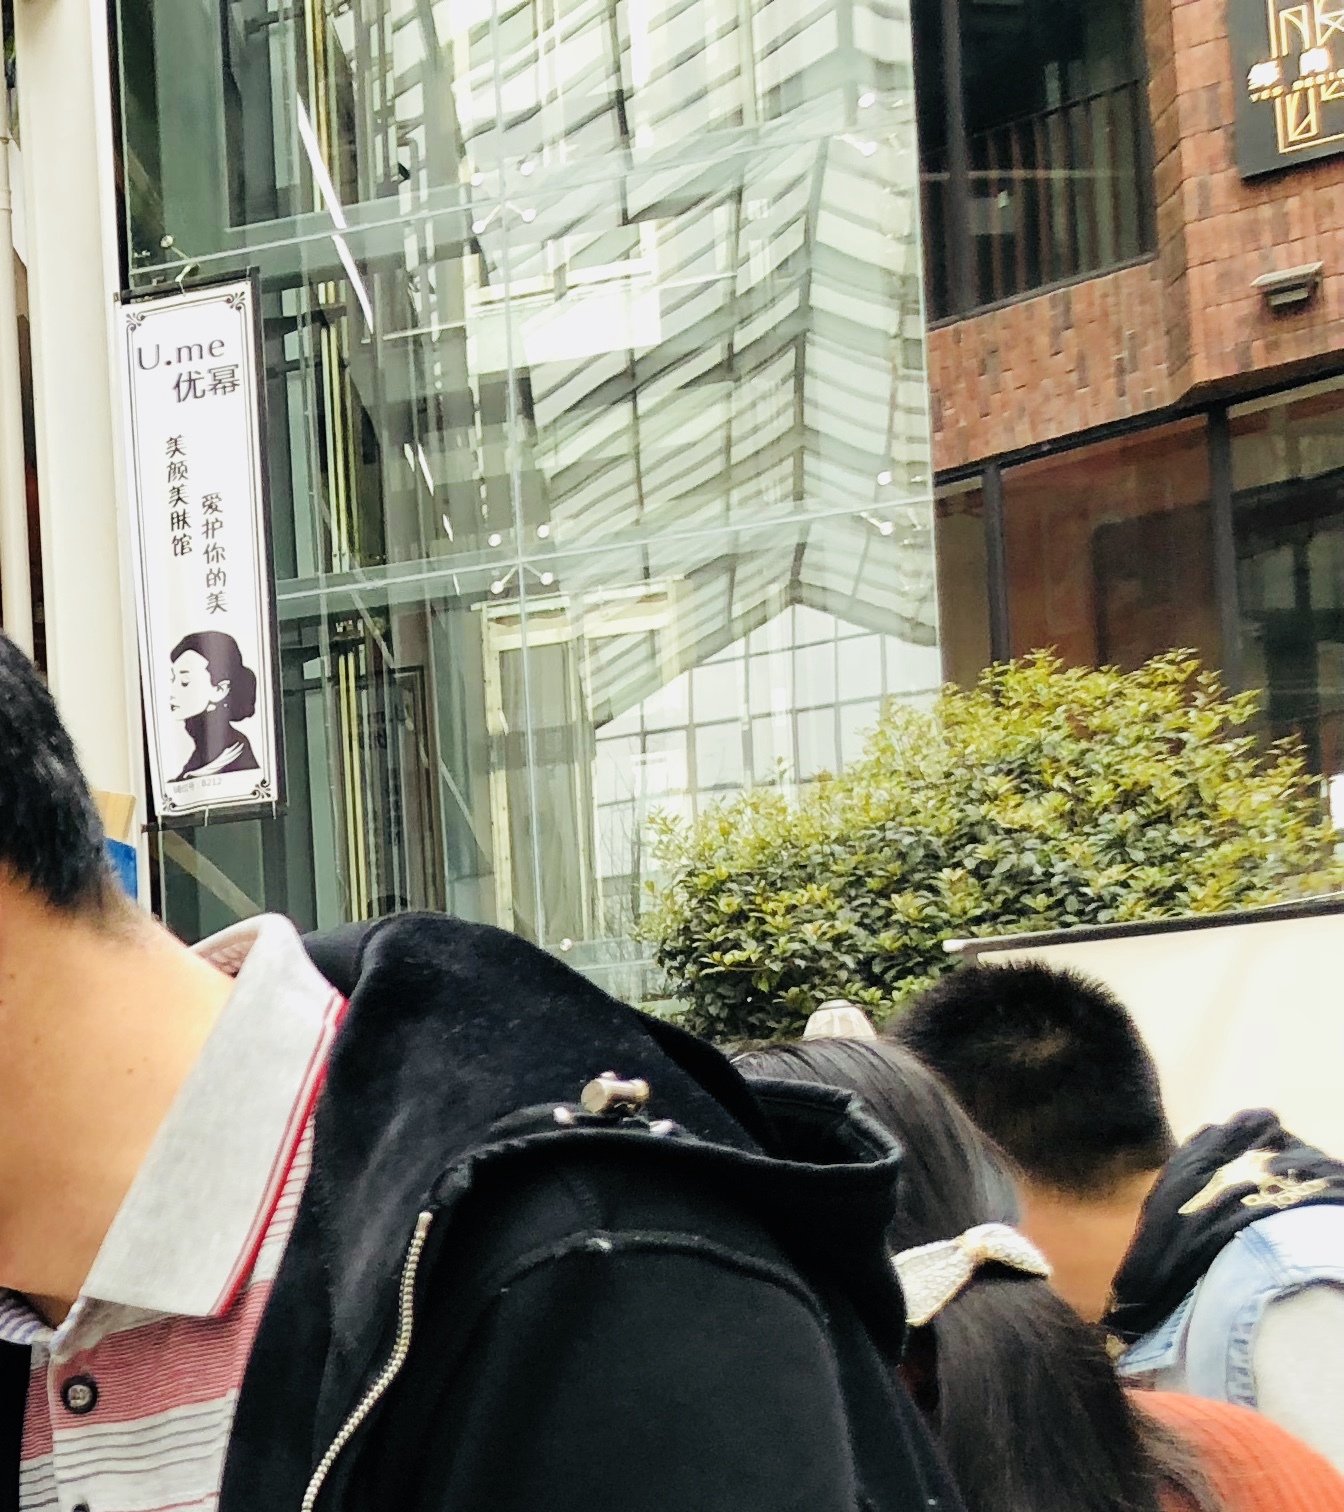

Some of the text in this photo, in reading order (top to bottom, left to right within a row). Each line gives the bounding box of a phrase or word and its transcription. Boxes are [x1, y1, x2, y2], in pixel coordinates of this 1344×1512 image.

[138, 337, 227, 371] U.me
[165, 435, 193, 557] 美颜美肤馆
[201, 492, 229, 614] 爱护你的美
